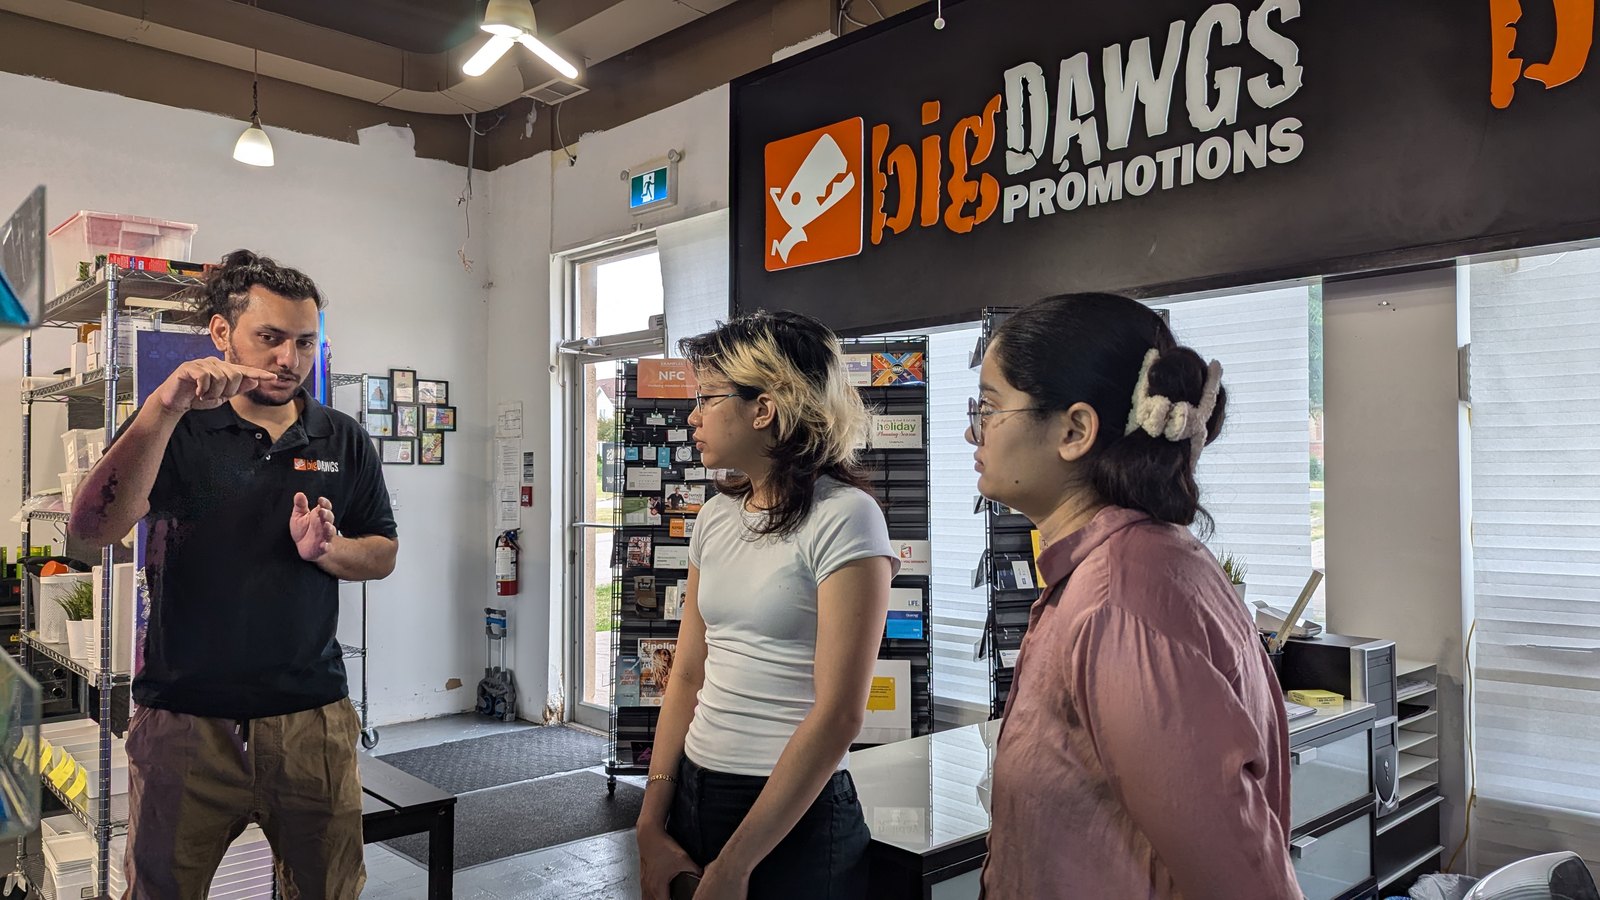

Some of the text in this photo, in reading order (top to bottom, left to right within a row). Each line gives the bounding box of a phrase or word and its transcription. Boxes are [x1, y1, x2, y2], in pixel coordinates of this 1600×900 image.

[1002, 116, 1304, 224] PROMOTIONS
[659, 371, 686, 381] NFC
[877, 423, 916, 432] holiday
[641, 642, 677, 651] Pipelin
